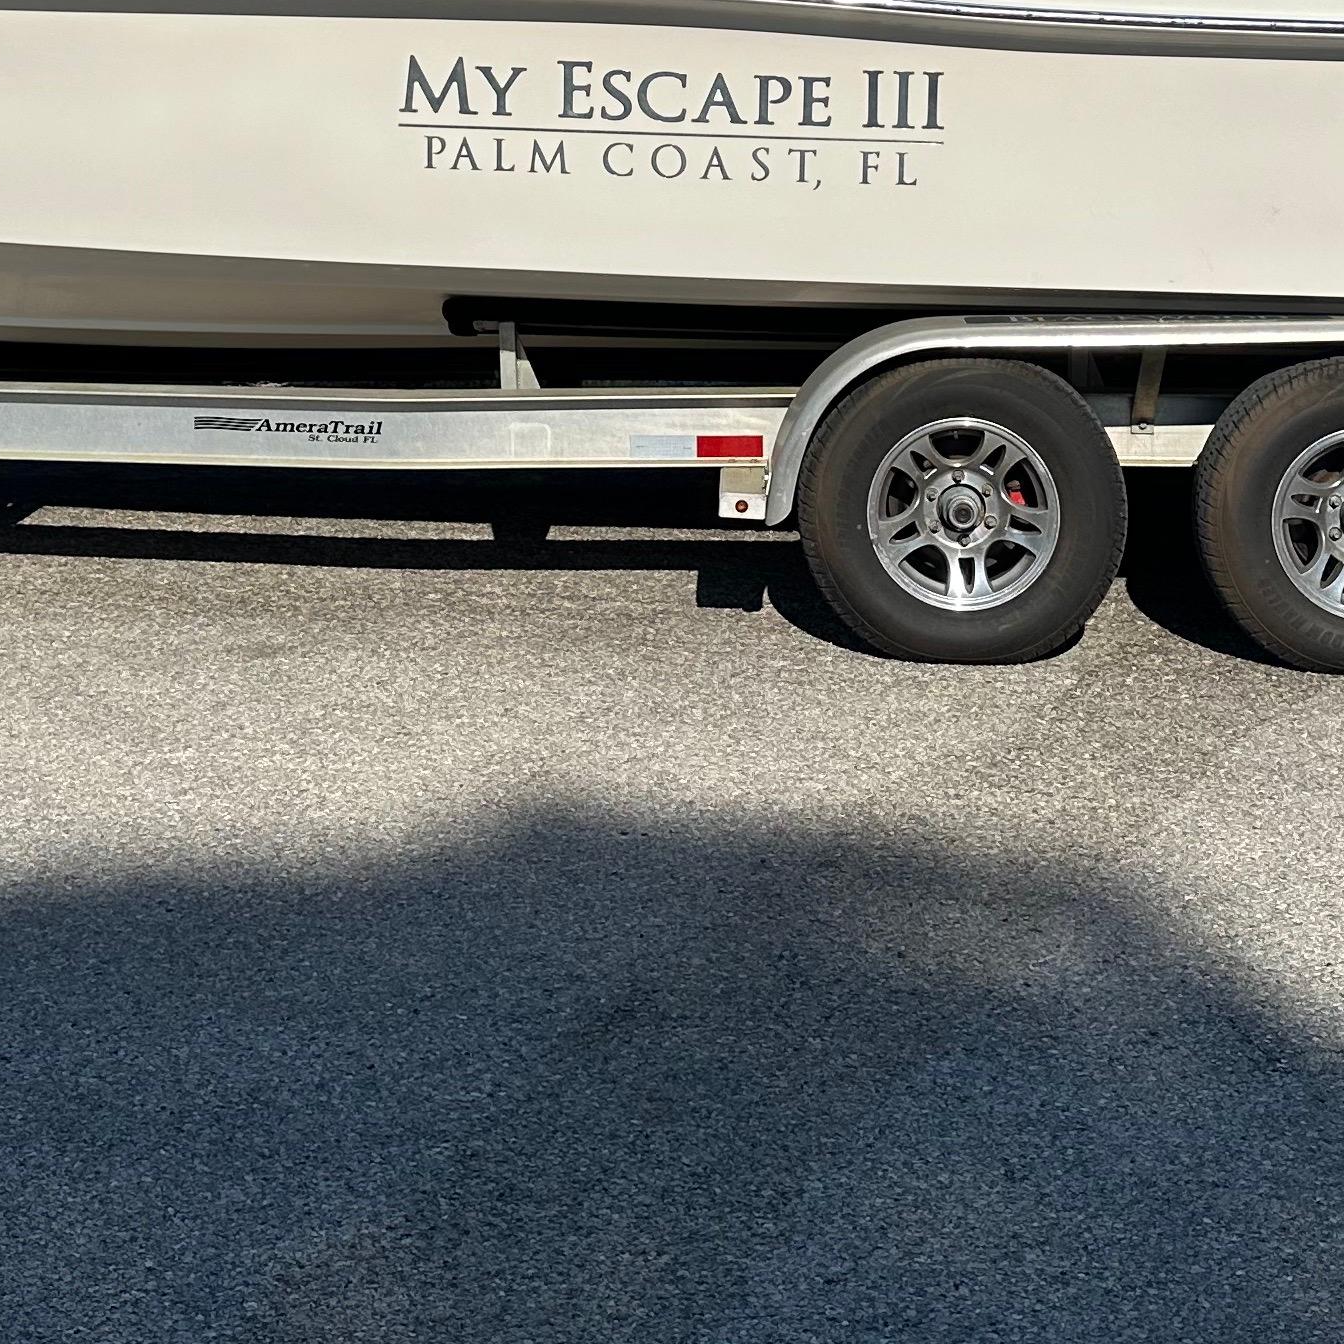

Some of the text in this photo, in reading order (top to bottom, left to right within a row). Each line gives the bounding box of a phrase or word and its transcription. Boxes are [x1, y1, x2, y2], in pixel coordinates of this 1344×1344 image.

[398, 54, 945, 130] MY ESCAPE III
[423, 135, 918, 191] PALM COAST, FL
[256, 418, 383, 436] AmeraTrail
[327, 434, 359, 443] Cloud
[363, 435, 379, 444] FL
